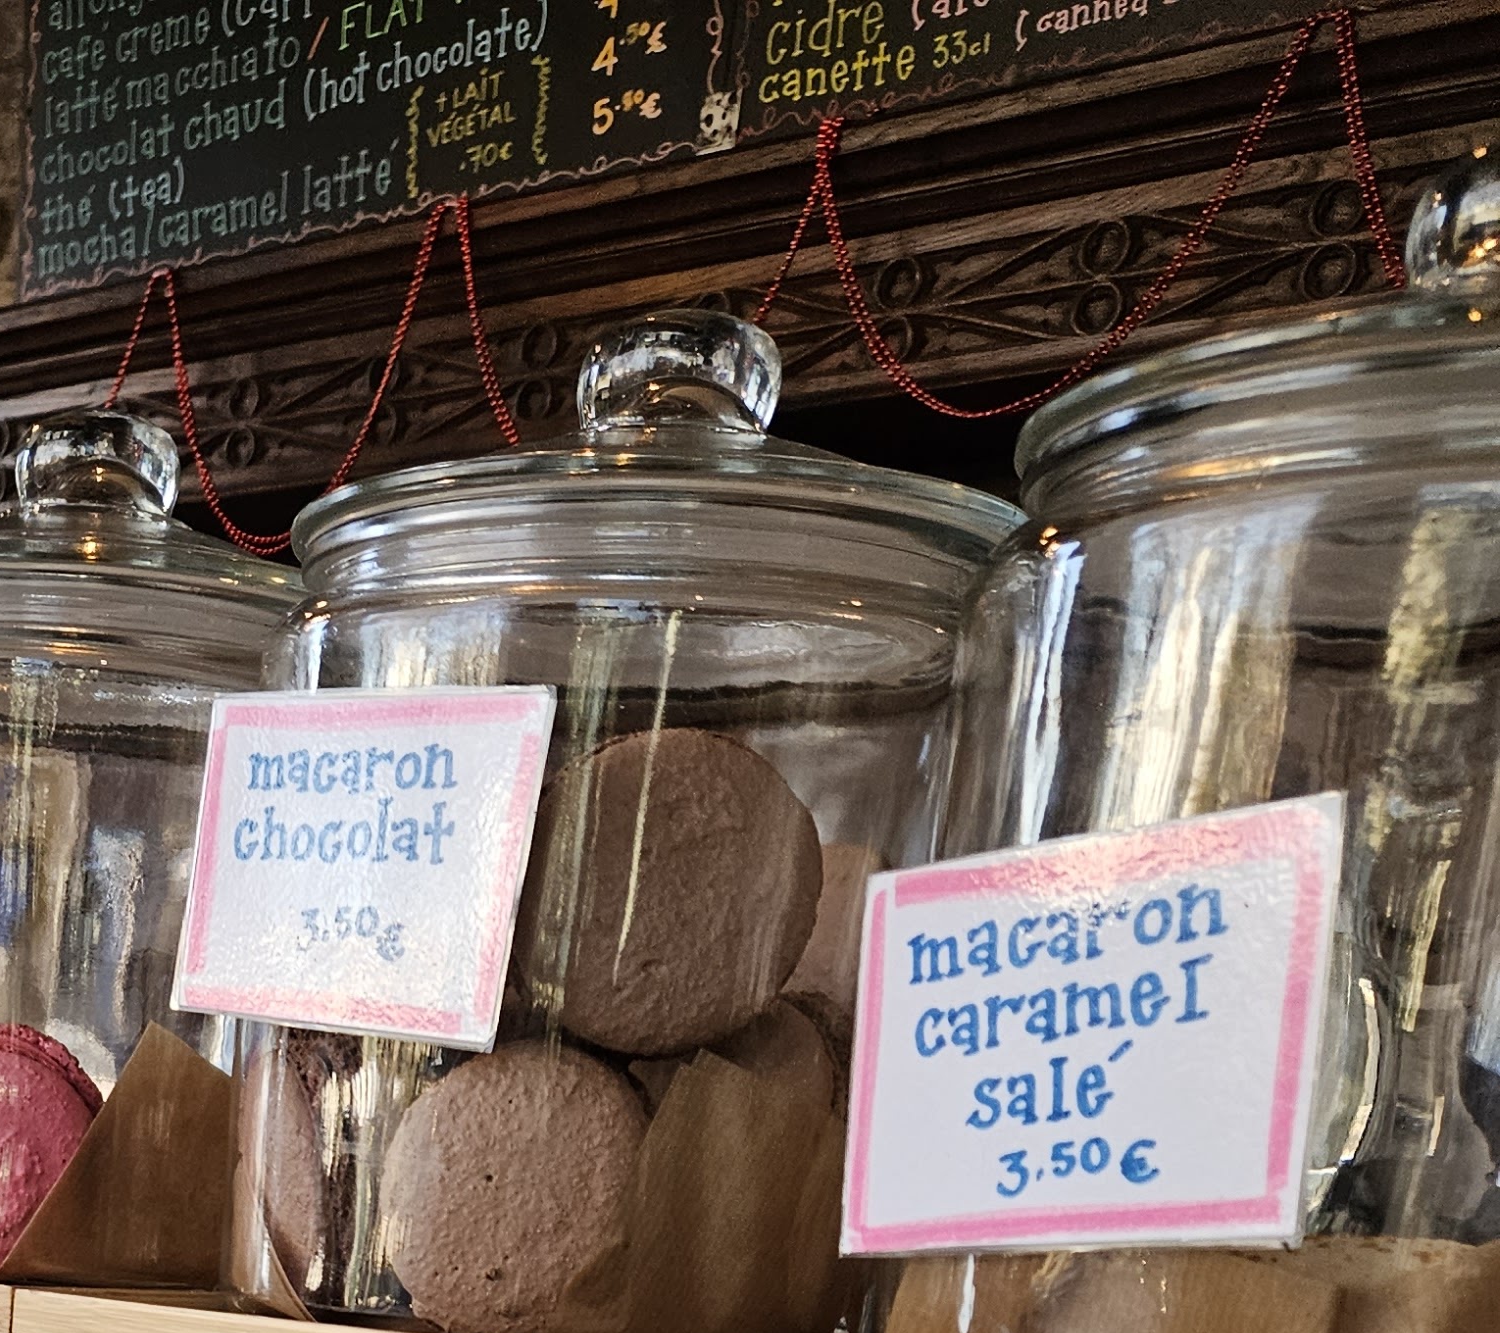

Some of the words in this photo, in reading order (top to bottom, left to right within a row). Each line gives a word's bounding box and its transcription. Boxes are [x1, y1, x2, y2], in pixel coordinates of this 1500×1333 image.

[39, 114, 175, 184] chocolat
[183, 78, 287, 150] chaud
[303, 51, 370, 122] (hot
[377, 0, 549, 92] chocolate)
[125, 23, 300, 110] macchiato
[758, 41, 916, 103] canette
[40, 185, 96, 235] thé
[109, 156, 185, 220] (tea)
[248, 743, 457, 795] macaron
[233, 797, 456, 865] chocolat
[908, 882, 1229, 985] macaron
[914, 953, 1215, 1058] caramel
[966, 1040, 1133, 1130] salé
